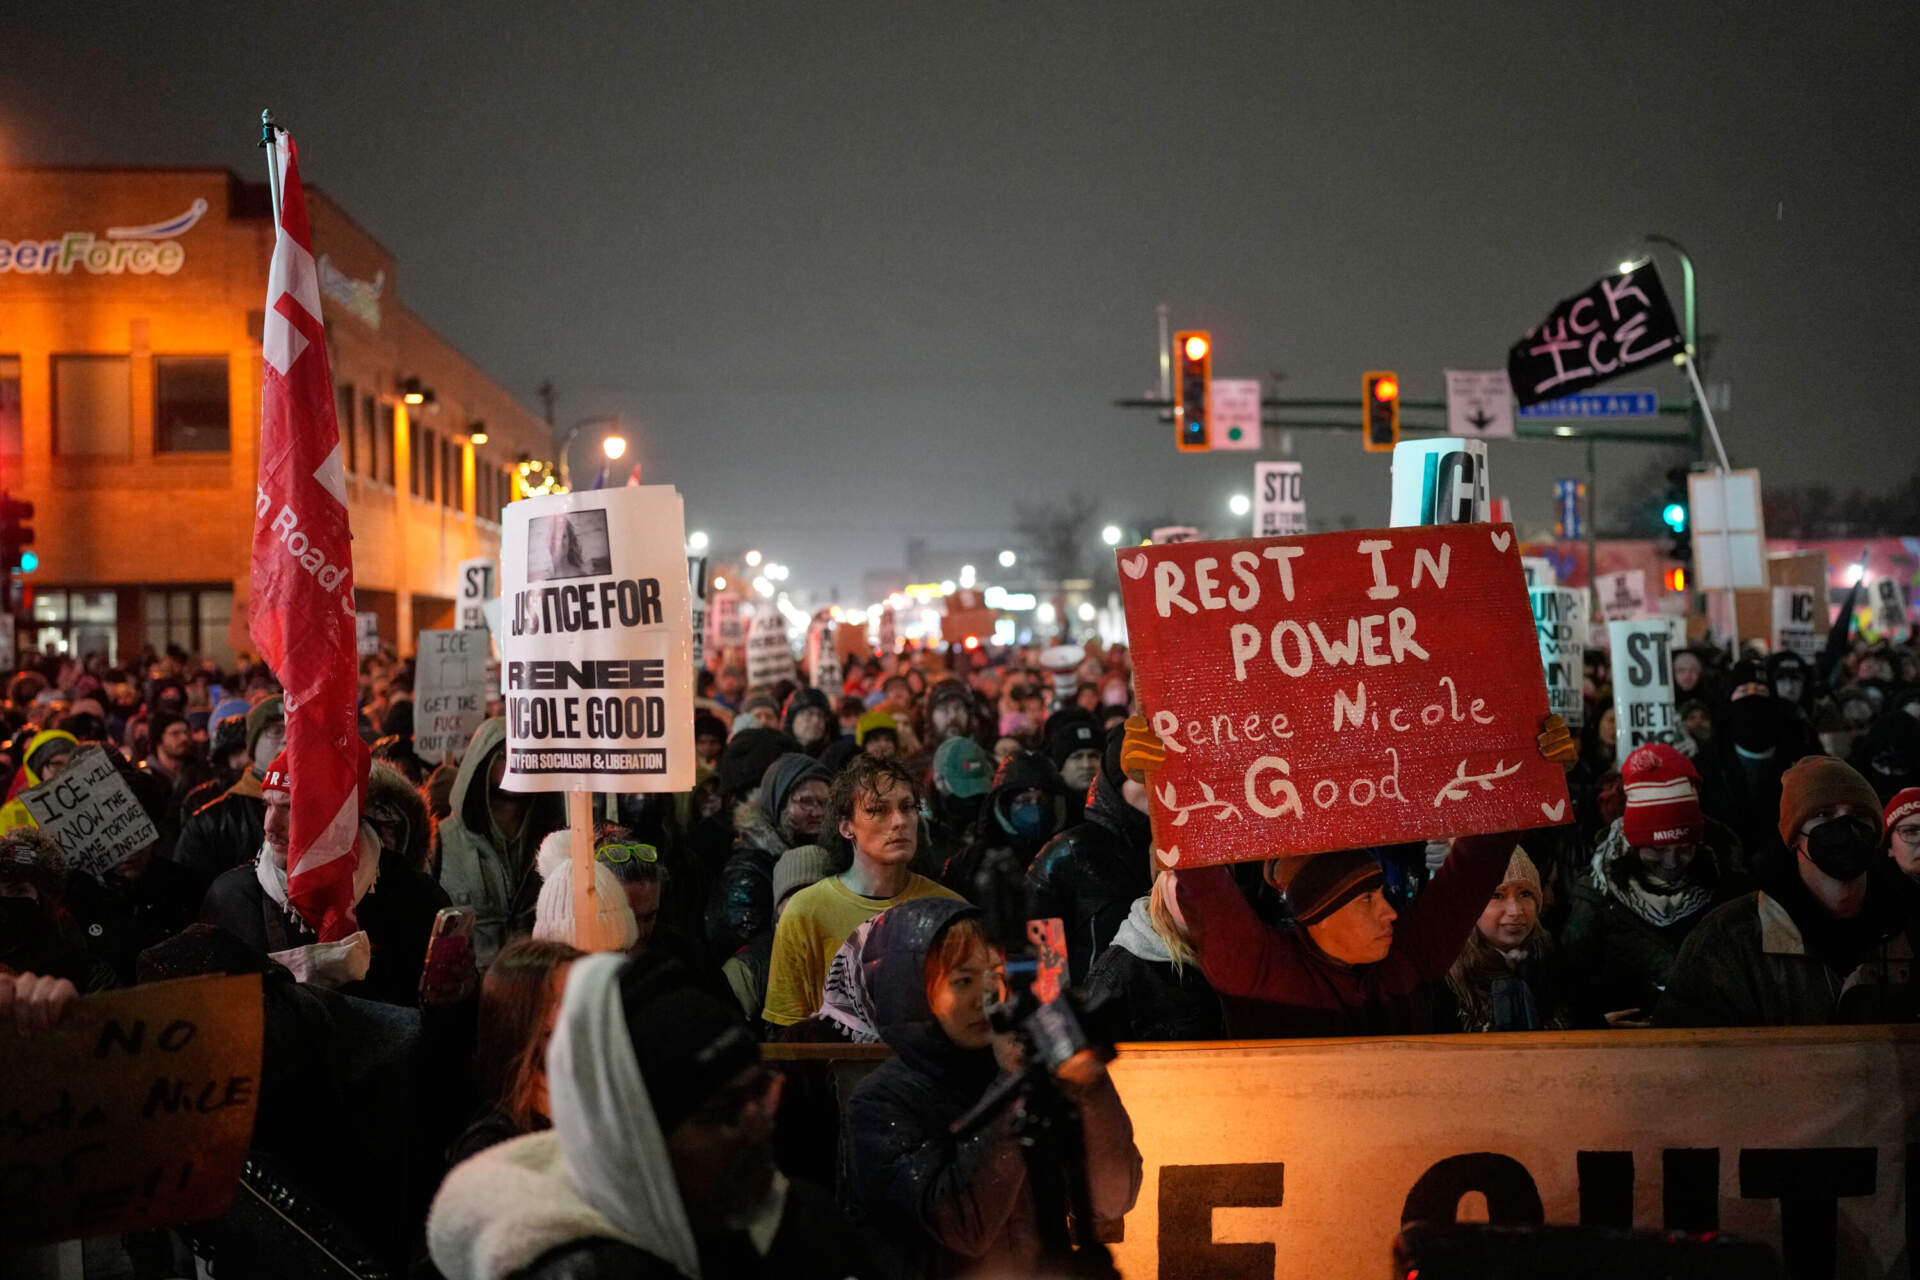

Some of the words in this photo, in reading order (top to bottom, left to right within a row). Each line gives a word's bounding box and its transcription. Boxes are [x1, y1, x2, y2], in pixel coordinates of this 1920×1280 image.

[1530, 312, 1673, 394] ICE
[270, 504, 349, 592] Road
[1154, 546, 1304, 617] REST
[512, 583, 599, 636] JUSTICE
[600, 578, 664, 629] FOR
[436, 634, 469, 653] ICE
[1230, 607, 1430, 681] POWER
[508, 659, 665, 690] RENEE
[424, 697, 449, 713] GET
[457, 696, 477, 712] THE
[433, 715, 462, 732] FUCK
[586, 696, 665, 739] GOOD
[1153, 710, 1294, 753] Renee
[1333, 677, 1495, 732] Nicole
[1630, 704, 1656, 727] ICE
[420, 737, 442, 750] OUT
[521, 754, 539, 769] FOR
[540, 754, 591, 769] SOCIALISM
[592, 755, 605, 769] &
[605, 753, 663, 769] LIBERATION
[31, 776, 91, 824] ICE
[84, 763, 118, 786] WILL
[1244, 748, 1408, 819] Good
[54, 803, 105, 855] KNOW
[102, 790, 127, 812] THE
[69, 838, 106, 868] SAME
[101, 804, 144, 840] TORTURE
[113, 823, 153, 858] INFLICT
[95, 1018, 196, 1059] NO
